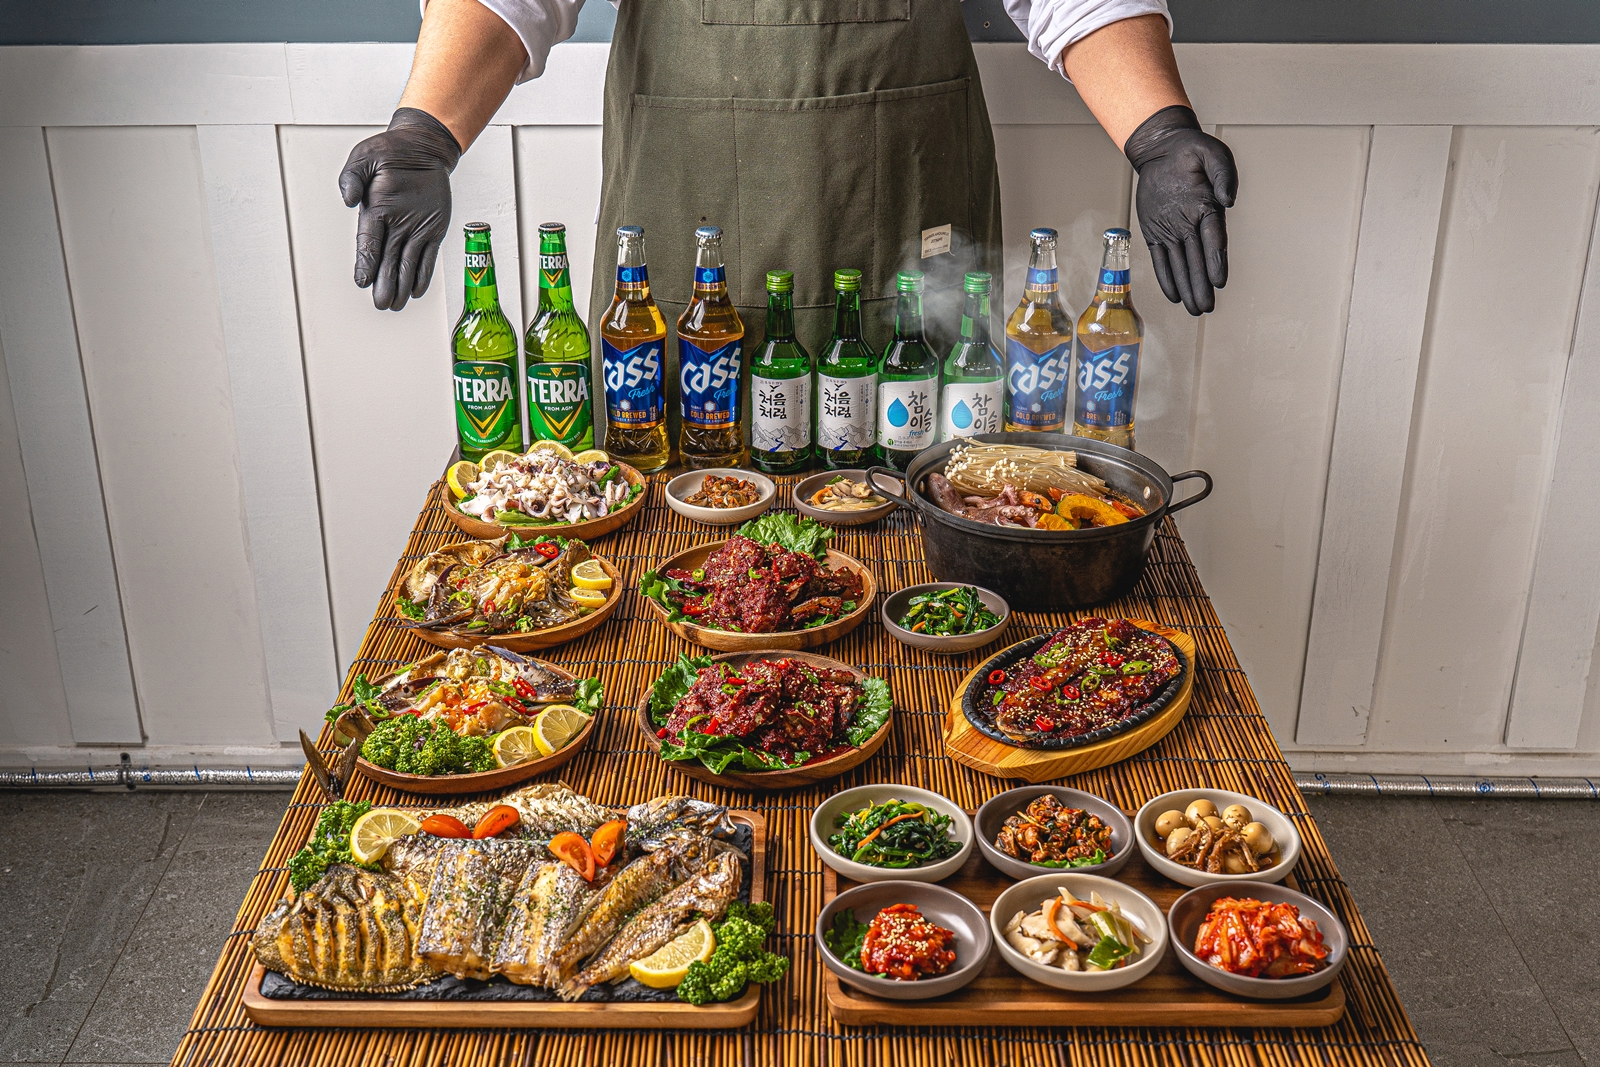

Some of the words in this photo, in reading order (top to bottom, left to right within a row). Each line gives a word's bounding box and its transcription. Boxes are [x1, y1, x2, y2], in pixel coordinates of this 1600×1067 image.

[465, 254, 492, 267] TERRA
[540, 255, 567, 269] TERRA
[453, 374, 513, 402] TERRA
[528, 376, 589, 403] TERRA
[628, 383, 655, 399] Fresh
[1094, 387, 1123, 401] Fresh
[759, 390, 786, 406] 처음
[824, 388, 851, 404] 처음
[908, 391, 928, 414] 참
[759, 404, 787, 419] 처럼
[824, 403, 851, 418] 처럼
[972, 393, 992, 416] 참
[690, 410, 704, 418] COLD
[706, 411, 730, 419] BREWED
[1015, 411, 1030, 420] COLD
